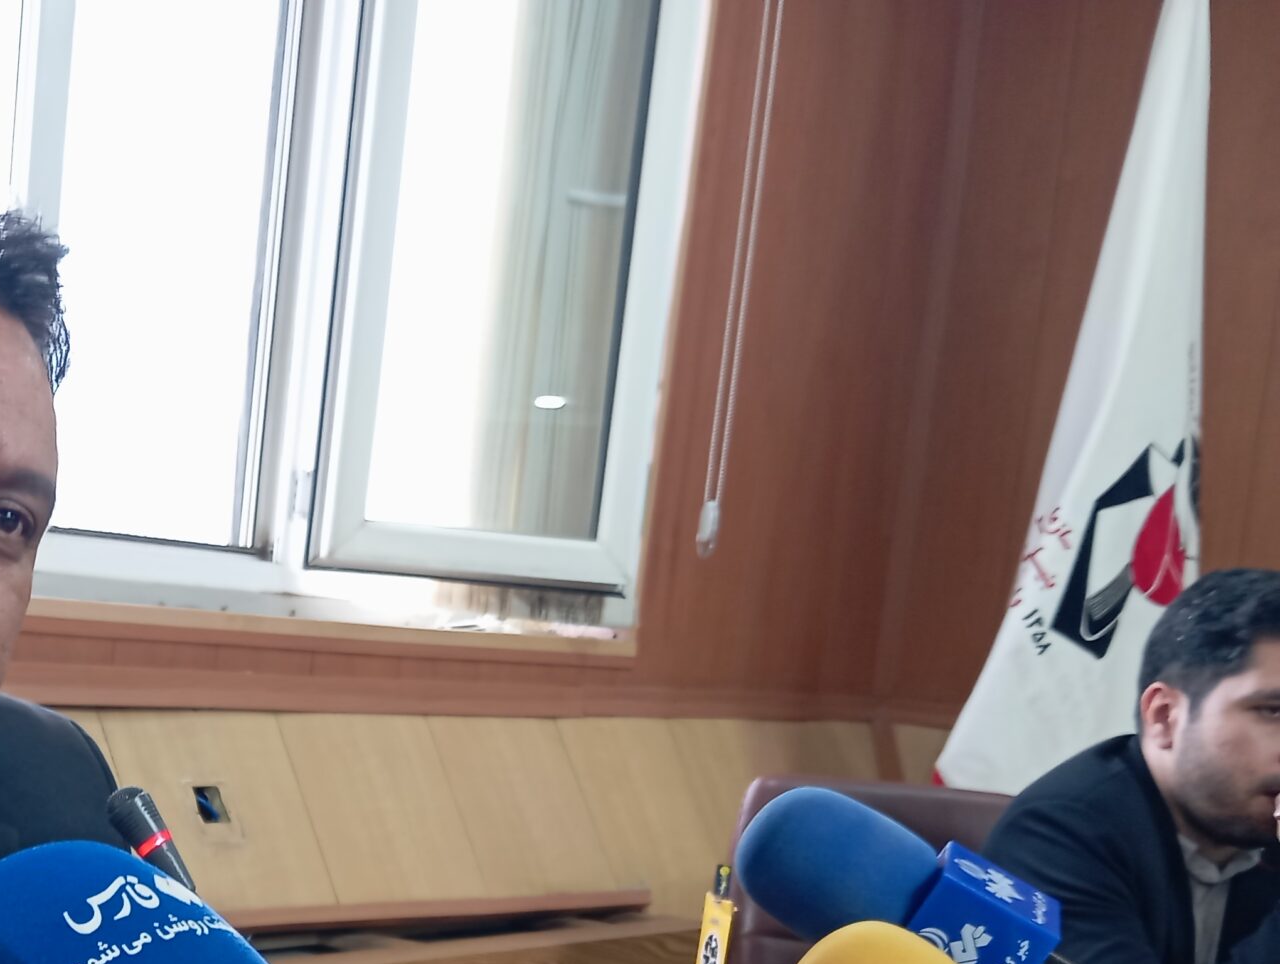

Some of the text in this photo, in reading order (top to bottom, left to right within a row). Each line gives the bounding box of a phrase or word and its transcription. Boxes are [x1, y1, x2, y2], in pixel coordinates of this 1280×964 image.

[1022, 608, 1052, 656] ۱۳۵۸
[63, 875, 160, 934] فارس
[154, 913, 209, 940] روشن
